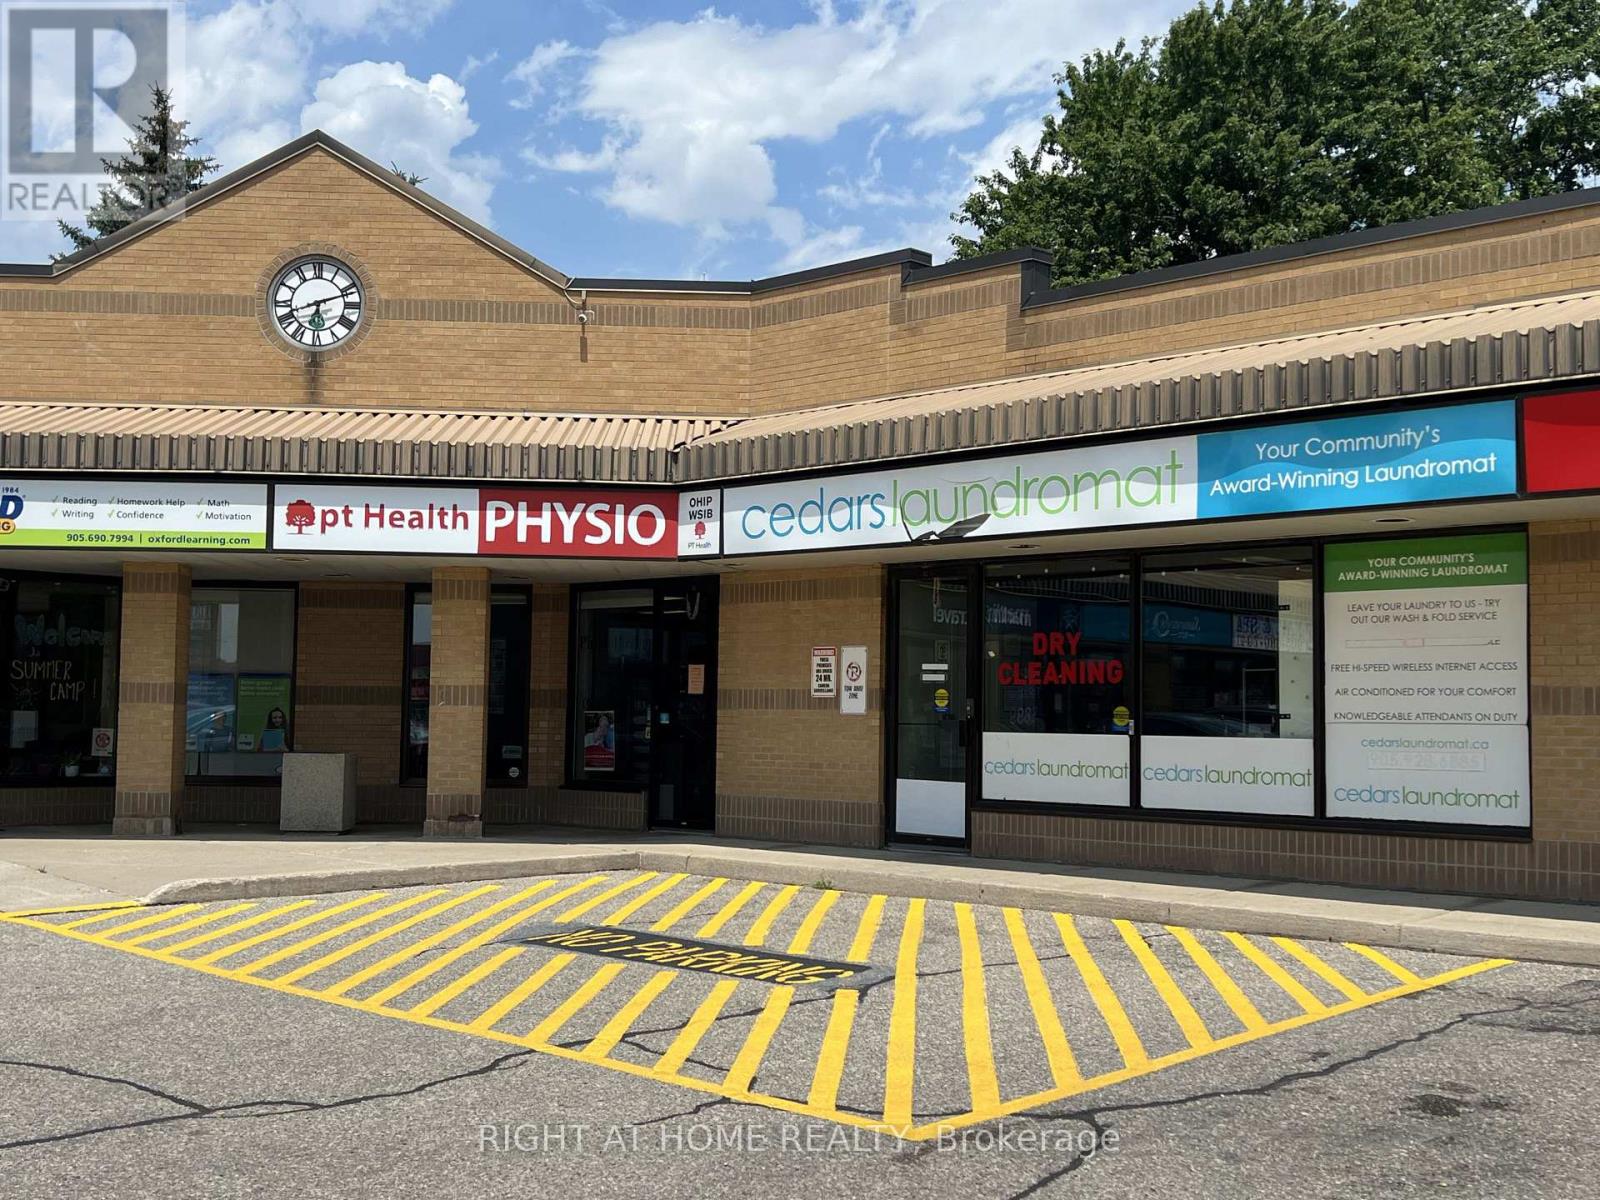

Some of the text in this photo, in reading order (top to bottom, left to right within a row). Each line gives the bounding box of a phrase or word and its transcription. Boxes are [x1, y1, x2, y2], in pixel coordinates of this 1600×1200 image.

[1255, 424, 1441, 460] Your Community's
[1209, 452, 1498, 497] Award-Winning Laundromat
[63, 496, 230, 507] Reading Homework Help Math
[689, 496, 713, 508] OHIP
[62, 509, 252, 521] Writing Confidence Motivation
[320, 503, 469, 535] pt Health
[688, 509, 713, 521] WSIB
[485, 501, 666, 546] PHYSIO
[66, 533, 251, 546] 905.690.7994 oxfordlearning.com
[1367, 553, 1475, 568] YOUR COMMUNITY'S
[1338, 564, 1508, 581] AWARD-WINNING LAUNDROMAT
[1347, 603, 1375, 613] LEAVE
[1377, 602, 1401, 611] YOUR
[1404, 600, 1447, 610] LAUNDRY
[1450, 599, 1463, 609] TO
[1464, 599, 1475, 608] US
[1485, 598, 1501, 608] TRY
[1350, 615, 1368, 624] OUT
[1371, 614, 1390, 624] OUR
[1393, 613, 1419, 623] WASH
[1432, 612, 1456, 622] FOLD
[1458, 611, 1498, 621] SERVICE
[1032, 632, 1081, 656] DRY
[10, 659, 73, 681] SUMMER
[997, 659, 1124, 686] CLEANING
[1330, 662, 1518, 672] FREE HI-SPEED WIRELESS INTERNET ACCESS
[815, 674, 823, 682] 24
[1334, 687, 1516, 696] AIR CONDITIONED FOR YOUR COMFORT
[1333, 712, 1518, 722] KNOWLEDGEABLE ATTENDANTS ON DUTY
[1361, 737, 1489, 750] cedarslaundromat.ca
[624, 941, 855, 985] PARKING
